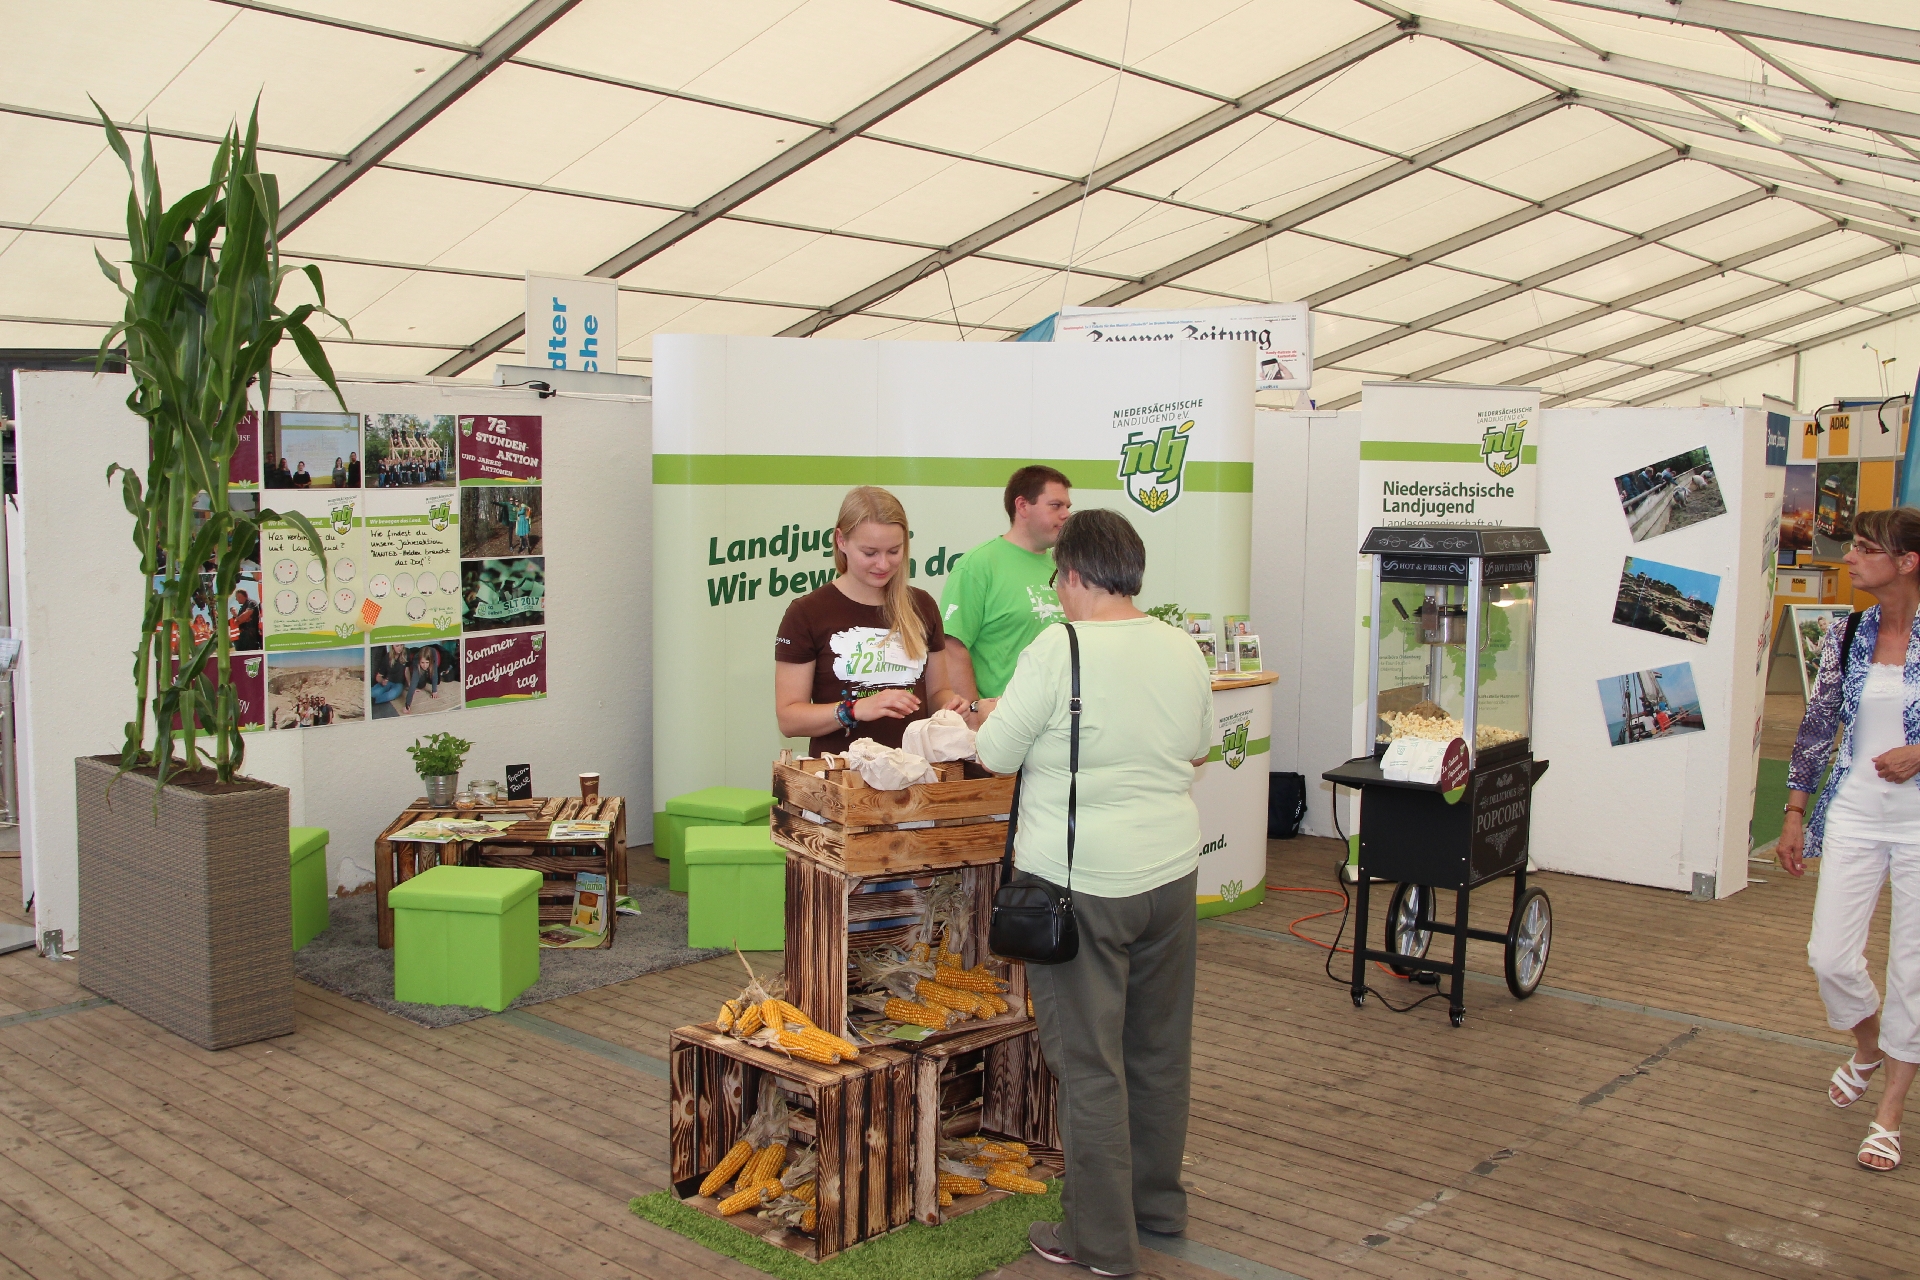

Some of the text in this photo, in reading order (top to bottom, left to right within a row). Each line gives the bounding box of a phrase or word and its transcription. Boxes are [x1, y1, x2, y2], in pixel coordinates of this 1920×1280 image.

[1113, 398, 1203, 419] NIEDERSÄCHSISCHE
[1477, 406, 1532, 417] NIEDERSÄCHSISCHE
[1112, 410, 1190, 429] LANDJUGEND e.V.
[1476, 415, 1516, 424] LANDJUGEND
[1829, 416, 1850, 431] ADAC
[475, 431, 529, 452] STUNDEN-
[461, 452, 476, 461] UND
[495, 449, 539, 467] AKTION
[1383, 480, 1515, 498] Niedersächsische
[1382, 498, 1475, 518] Landjugend
[325, 533, 336, 541] du
[370, 529, 383, 538] Wie
[387, 529, 411, 540] findest
[268, 543, 285, 552] mit
[1399, 562, 1415, 570] HOT
[1423, 563, 1448, 571] FRESH
[707, 572, 762, 607] Wir
[503, 599, 519, 610] SLT
[521, 597, 540, 606] 2017
[465, 650, 540, 690] Landjugend-
[851, 651, 874, 675] 72
[516, 673, 539, 688] tag
[1489, 787, 1517, 805] DELICIOUS
[1475, 799, 1527, 834] POPCORN
[1199, 834, 1228, 856] and.
